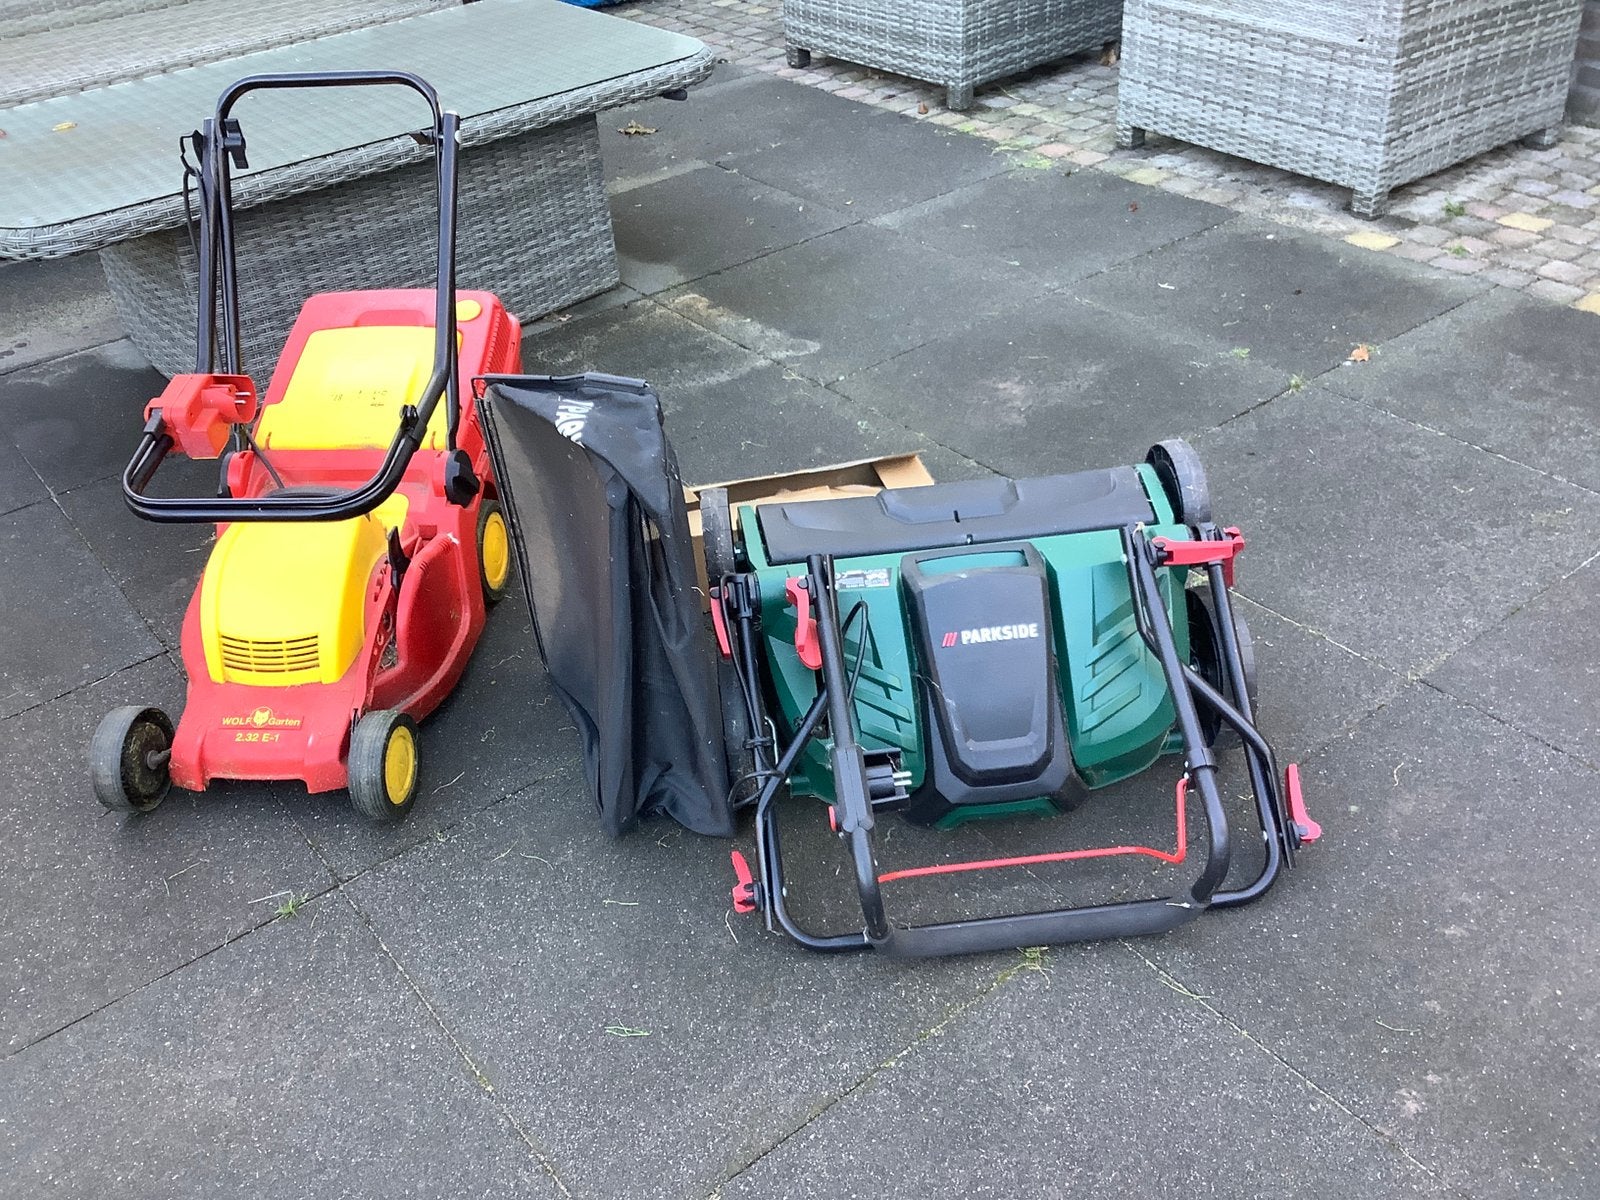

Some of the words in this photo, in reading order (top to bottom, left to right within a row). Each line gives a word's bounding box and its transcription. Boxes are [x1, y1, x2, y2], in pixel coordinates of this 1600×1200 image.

[961, 622, 1039, 645] PARKSIDE
[222, 717, 252, 726] WOLF
[267, 717, 301, 727] Garten
[235, 733, 259, 742] 2.32
[262, 733, 280, 742] E-1
